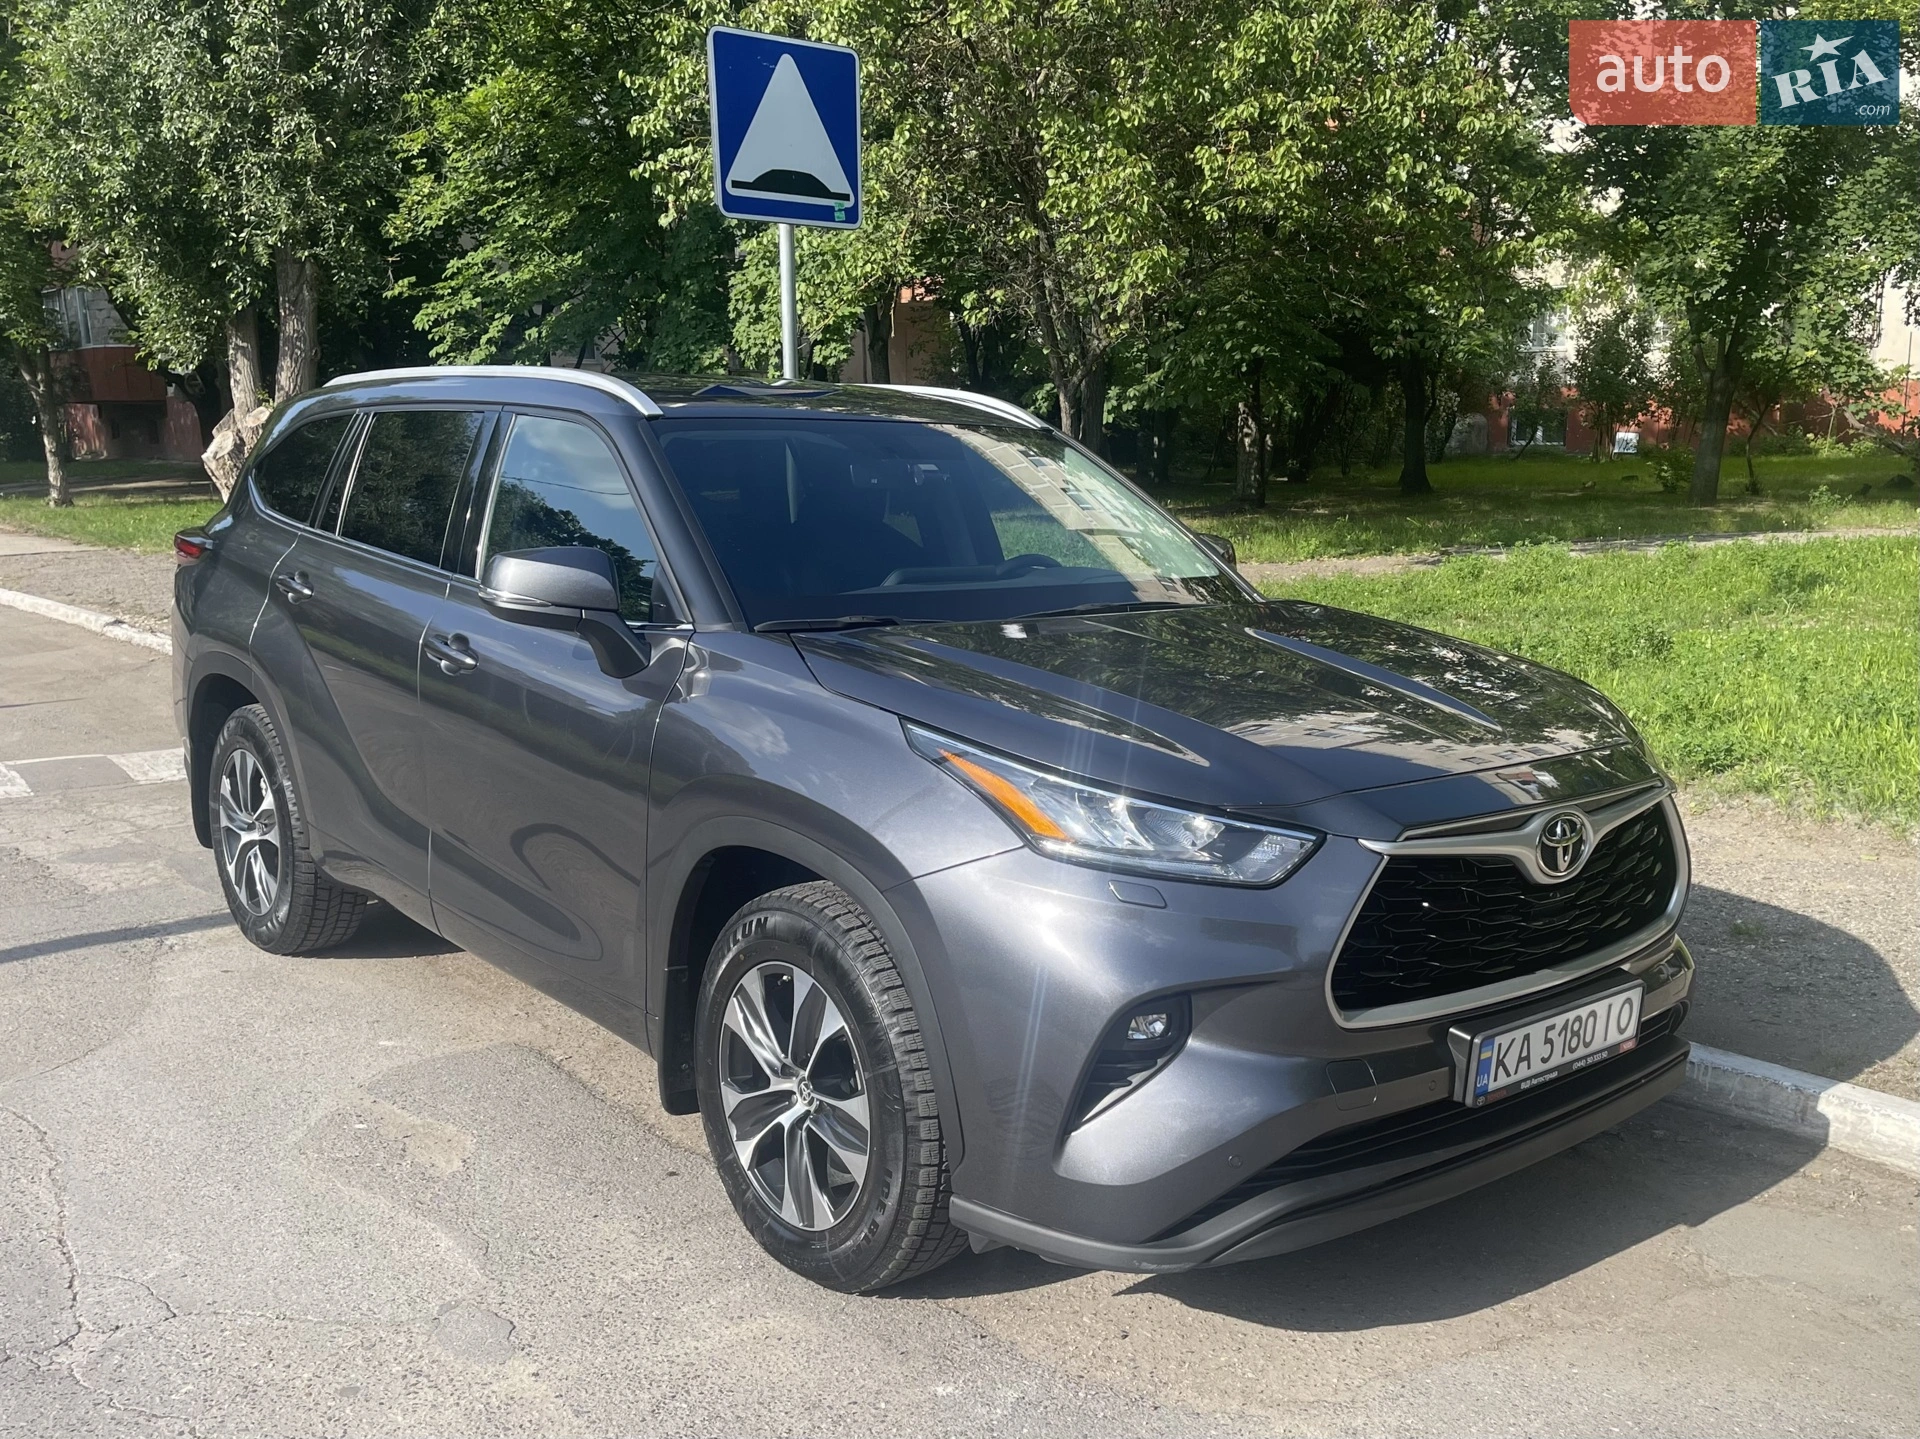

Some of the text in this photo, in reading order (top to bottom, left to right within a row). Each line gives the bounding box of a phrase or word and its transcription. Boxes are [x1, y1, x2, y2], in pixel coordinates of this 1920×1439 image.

[1493, 1032, 1531, 1083] KA
[1540, 1009, 1598, 1066] 5180
[1572, 1059, 1586, 1071] (044)
[1476, 1073, 1488, 1088] UA
